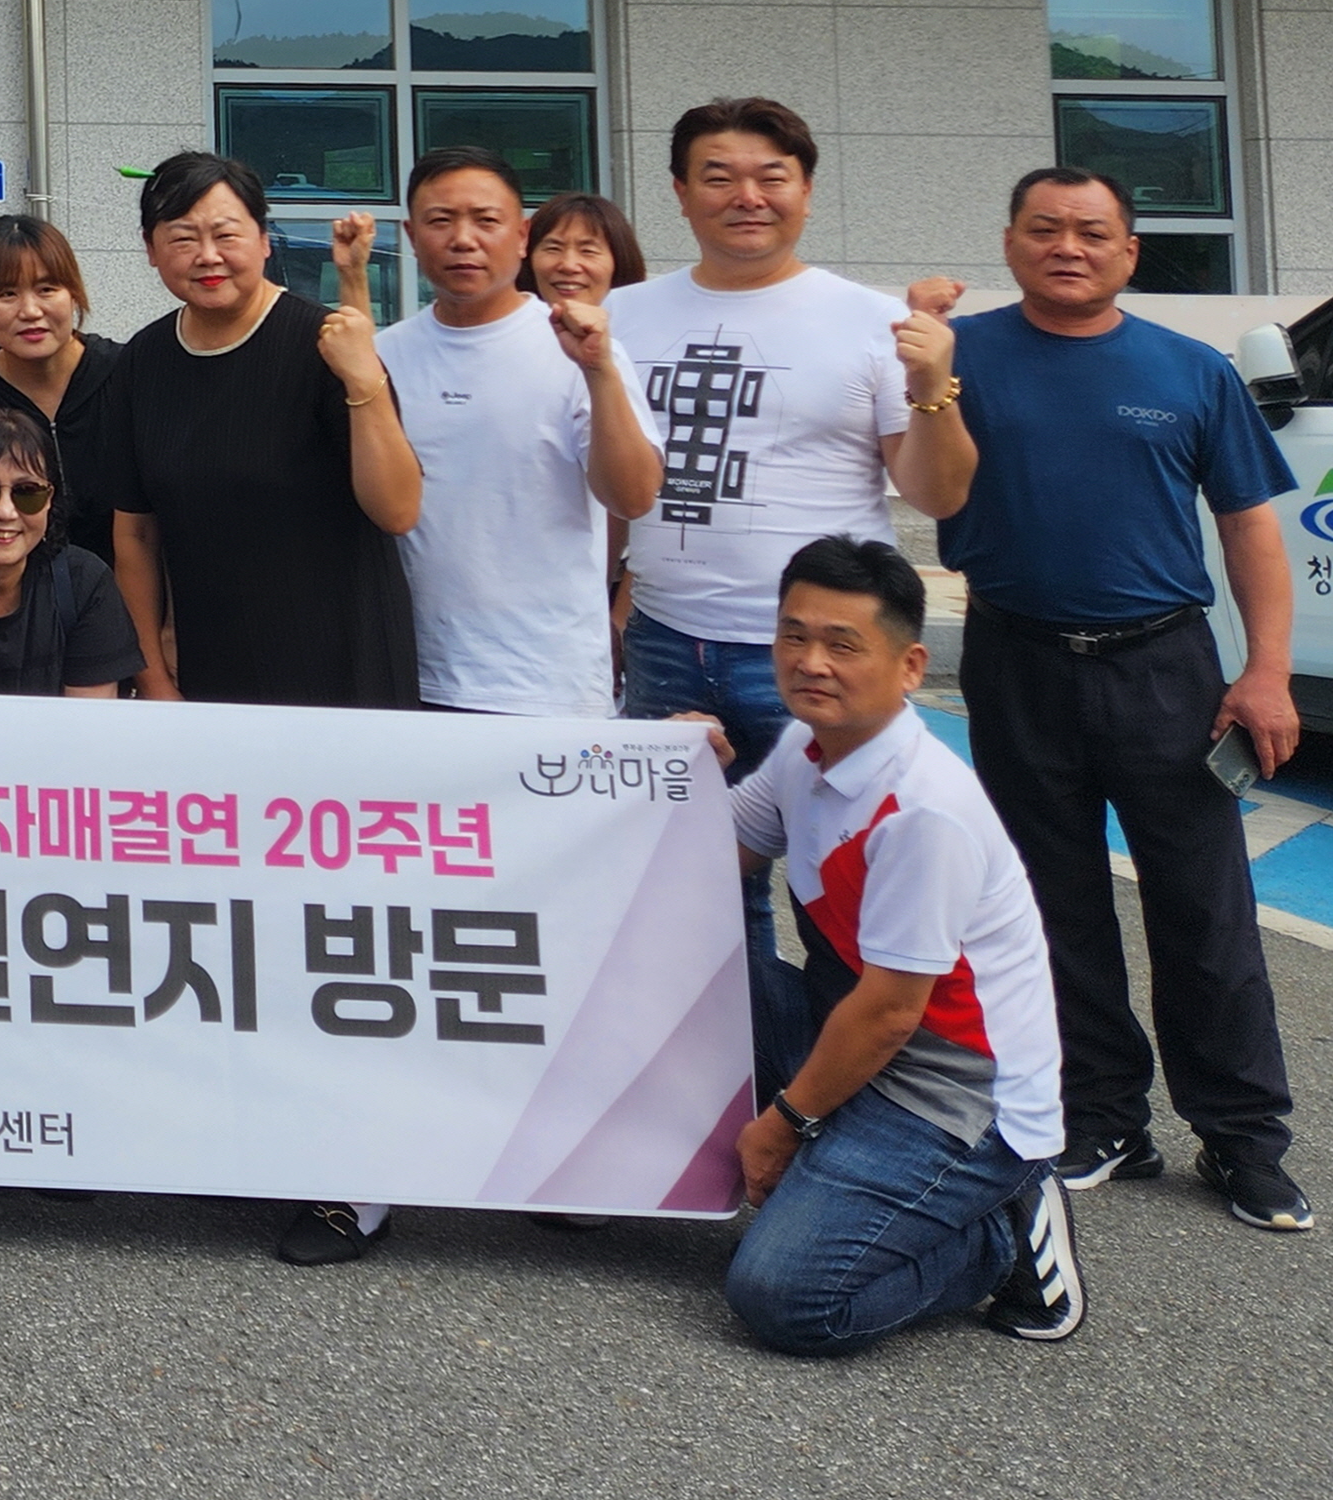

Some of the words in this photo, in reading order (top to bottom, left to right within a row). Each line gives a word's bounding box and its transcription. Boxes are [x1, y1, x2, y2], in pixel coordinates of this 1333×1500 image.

[1117, 404, 1178, 424] DOKDO
[1306, 553, 1333, 596] 청
[263, 797, 496, 879] 20주년
[302, 902, 547, 1046] 방문
